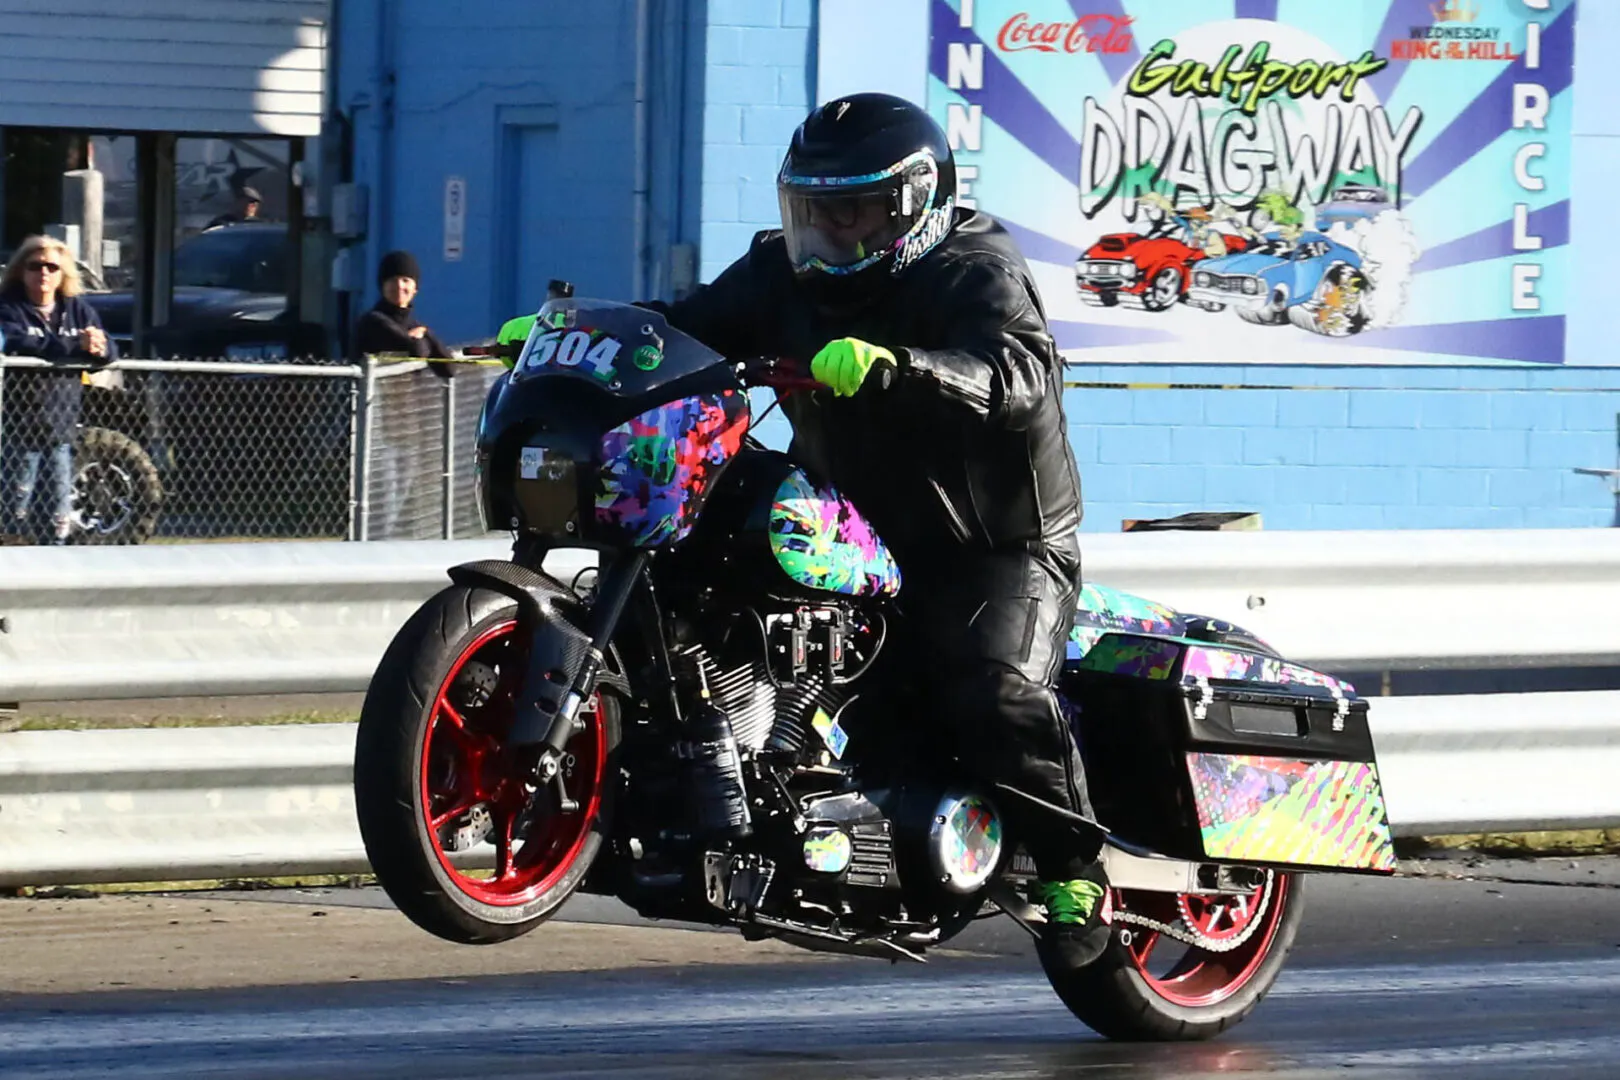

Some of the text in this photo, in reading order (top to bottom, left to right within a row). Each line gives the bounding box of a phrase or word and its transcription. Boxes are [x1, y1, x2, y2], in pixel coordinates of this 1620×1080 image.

[1390, 40, 1441, 60] KING
[1468, 42, 1520, 61] HILL
[1409, 26, 1500, 40] WEDNESDAY
[1127, 38, 1389, 117] Gulfport
[1078, 95, 1424, 221] DRAGWAY
[1511, 0, 1550, 311] IRCLE
[526, 330, 623, 377] 504
